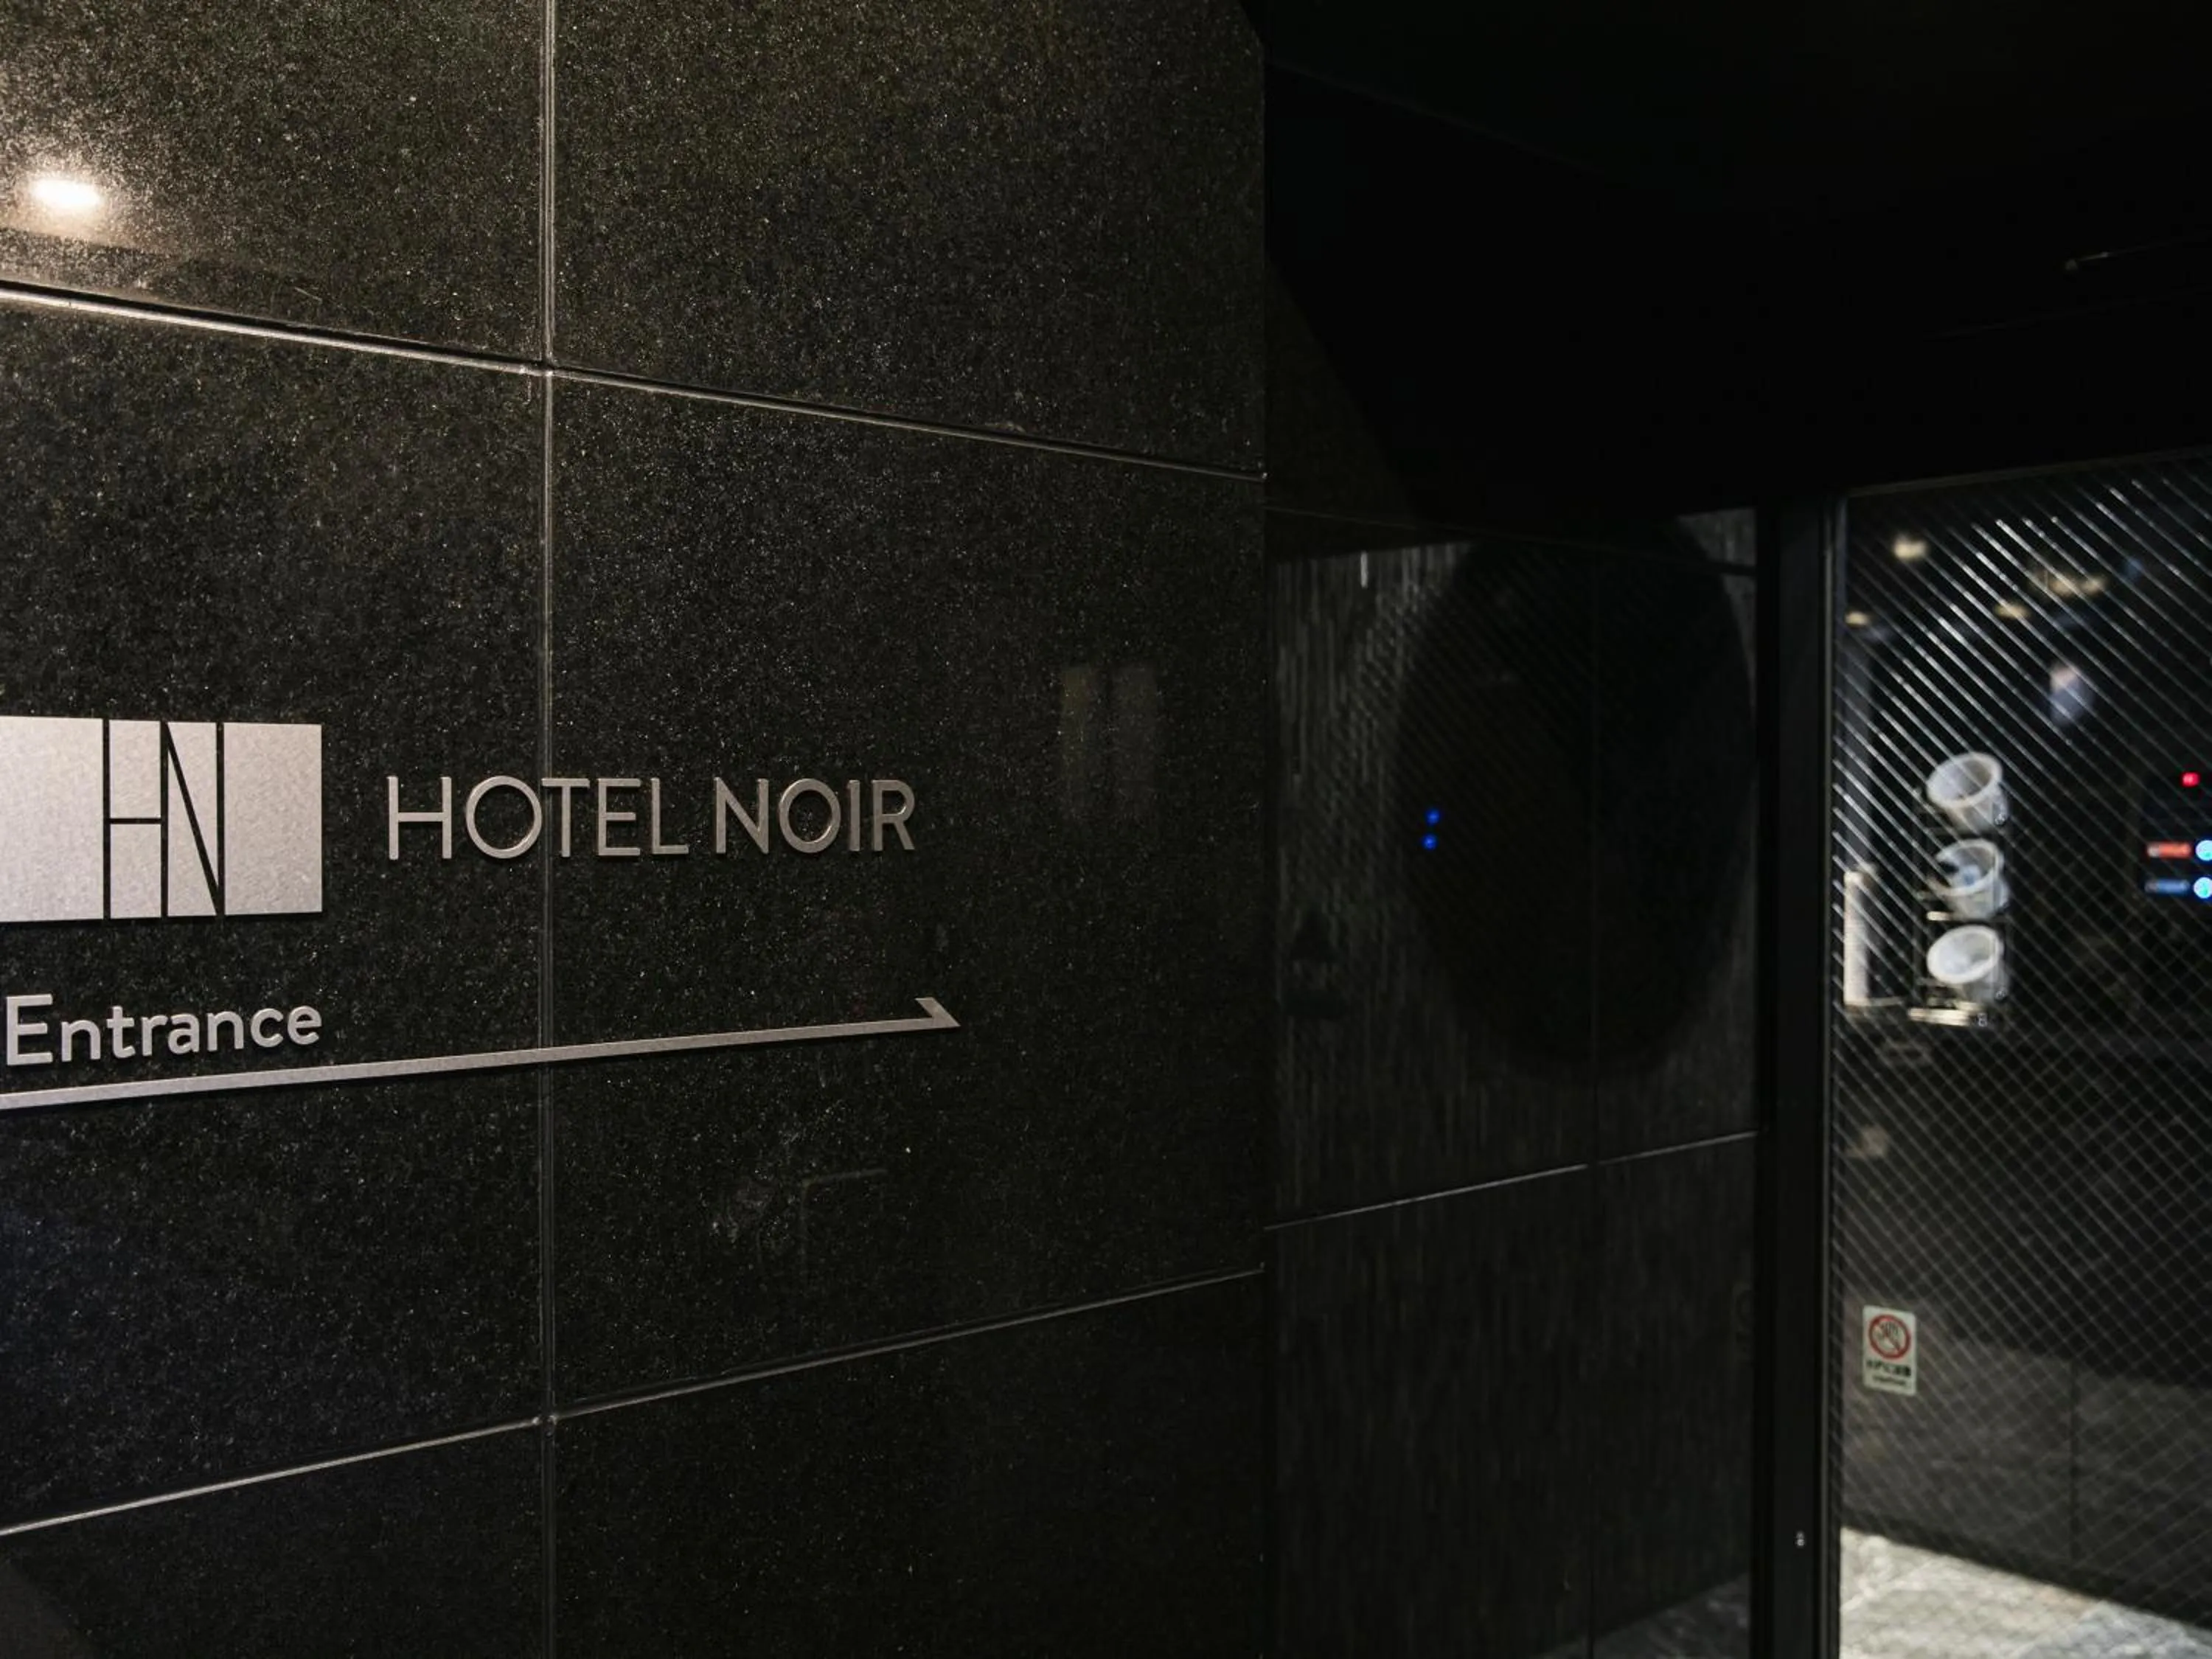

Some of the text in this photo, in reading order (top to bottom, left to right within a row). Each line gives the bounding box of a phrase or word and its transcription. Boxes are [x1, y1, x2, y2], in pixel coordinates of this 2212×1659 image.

[386, 775, 916, 860] HOTEL NOIR
[6, 993, 323, 1065] Entrance
